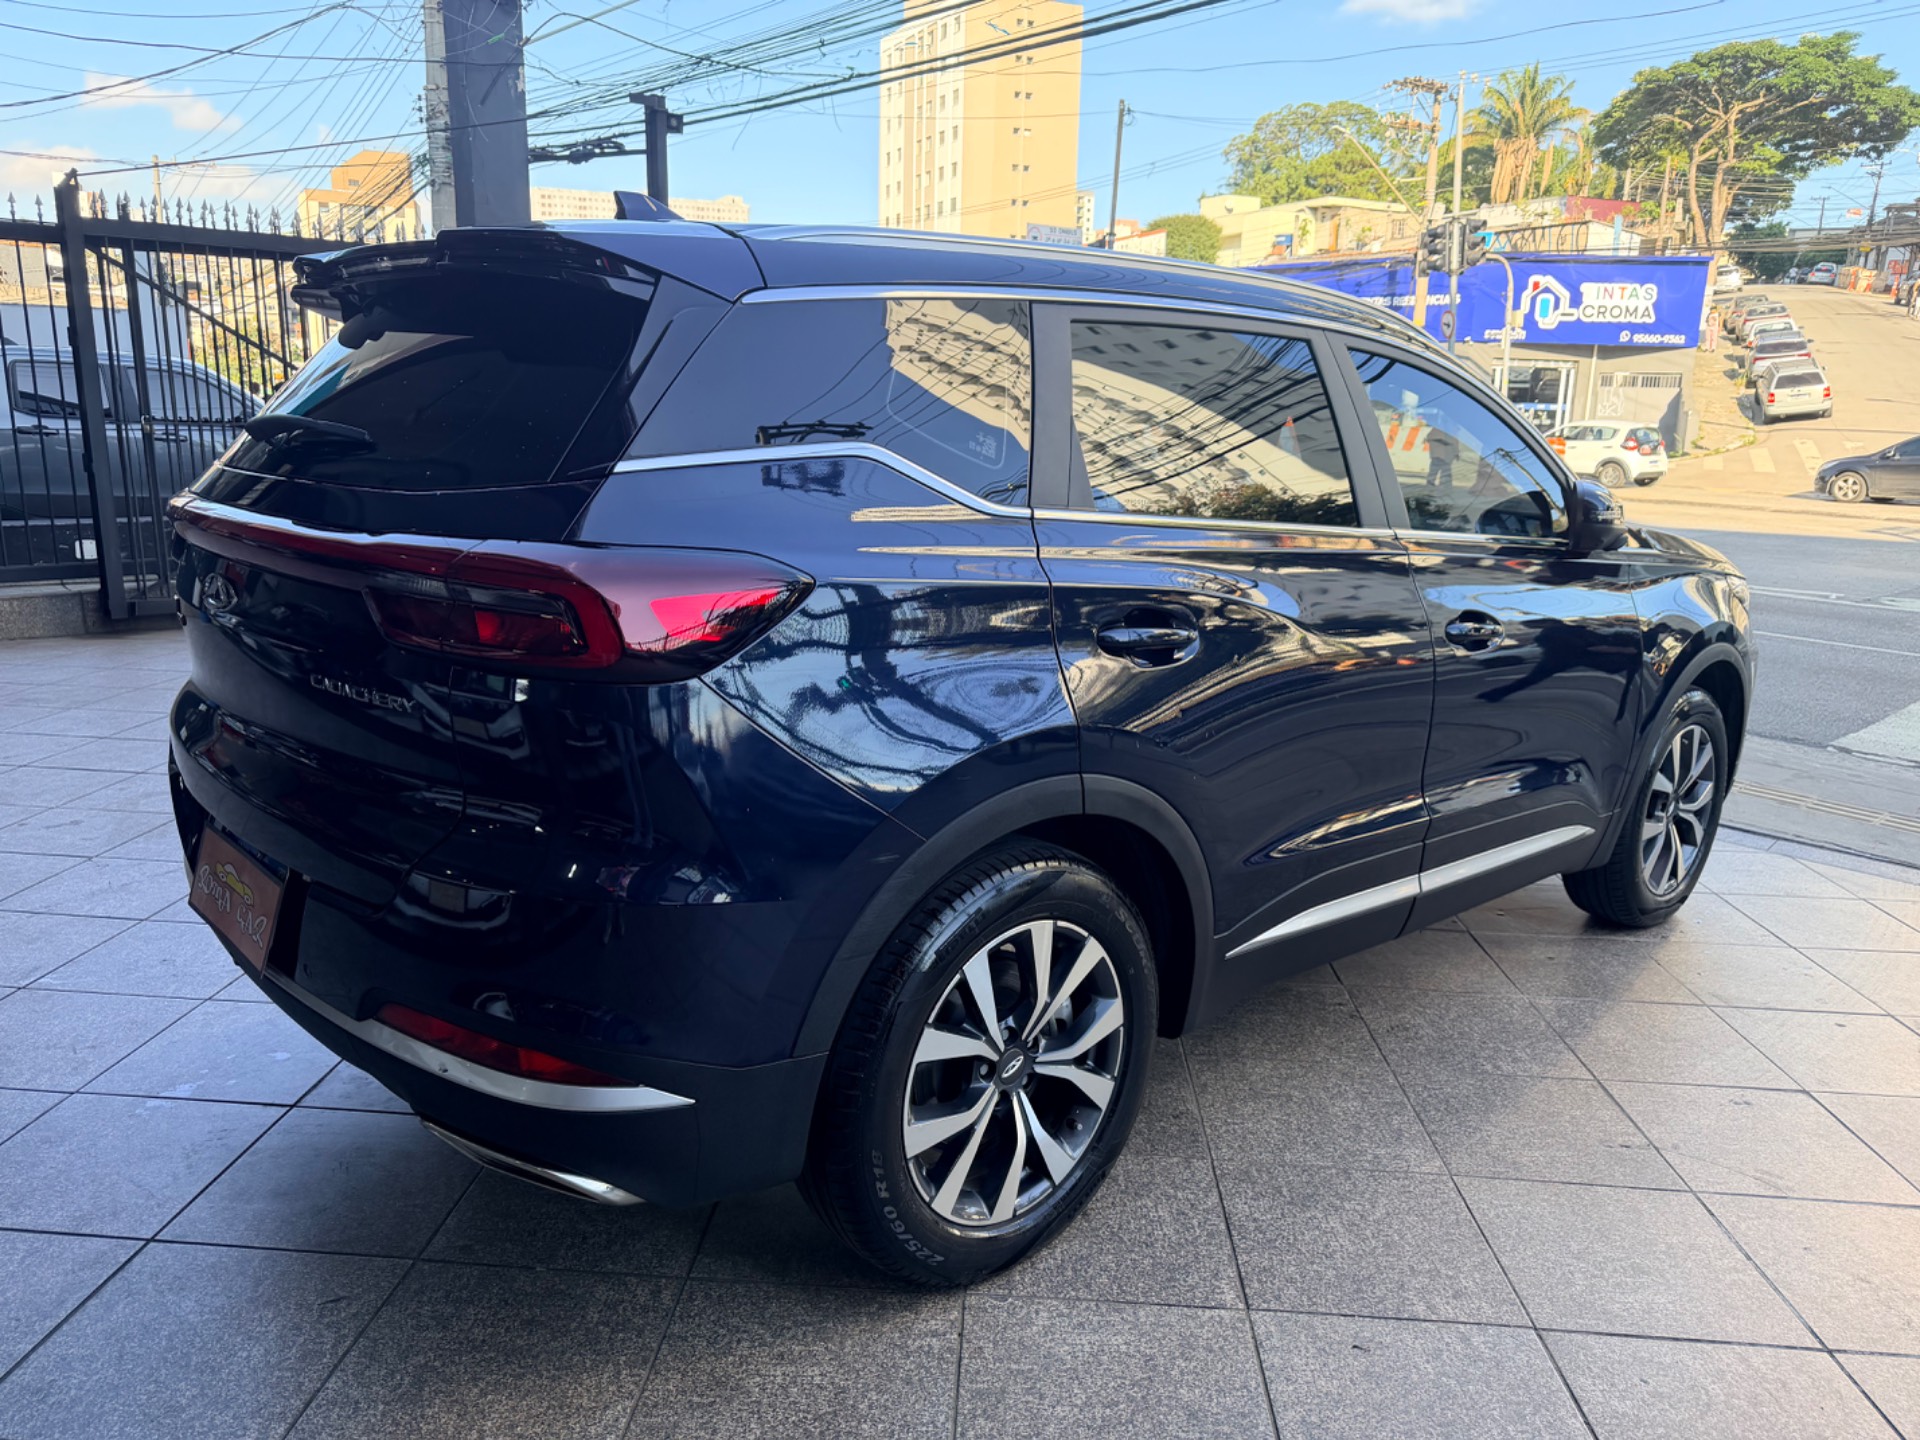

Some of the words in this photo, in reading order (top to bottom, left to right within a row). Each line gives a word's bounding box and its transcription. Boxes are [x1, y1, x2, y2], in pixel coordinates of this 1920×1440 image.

[1583, 286, 1654, 300] INTAS
[1582, 304, 1652, 319] CROMA
[883, 1205, 944, 1266] 225/60
